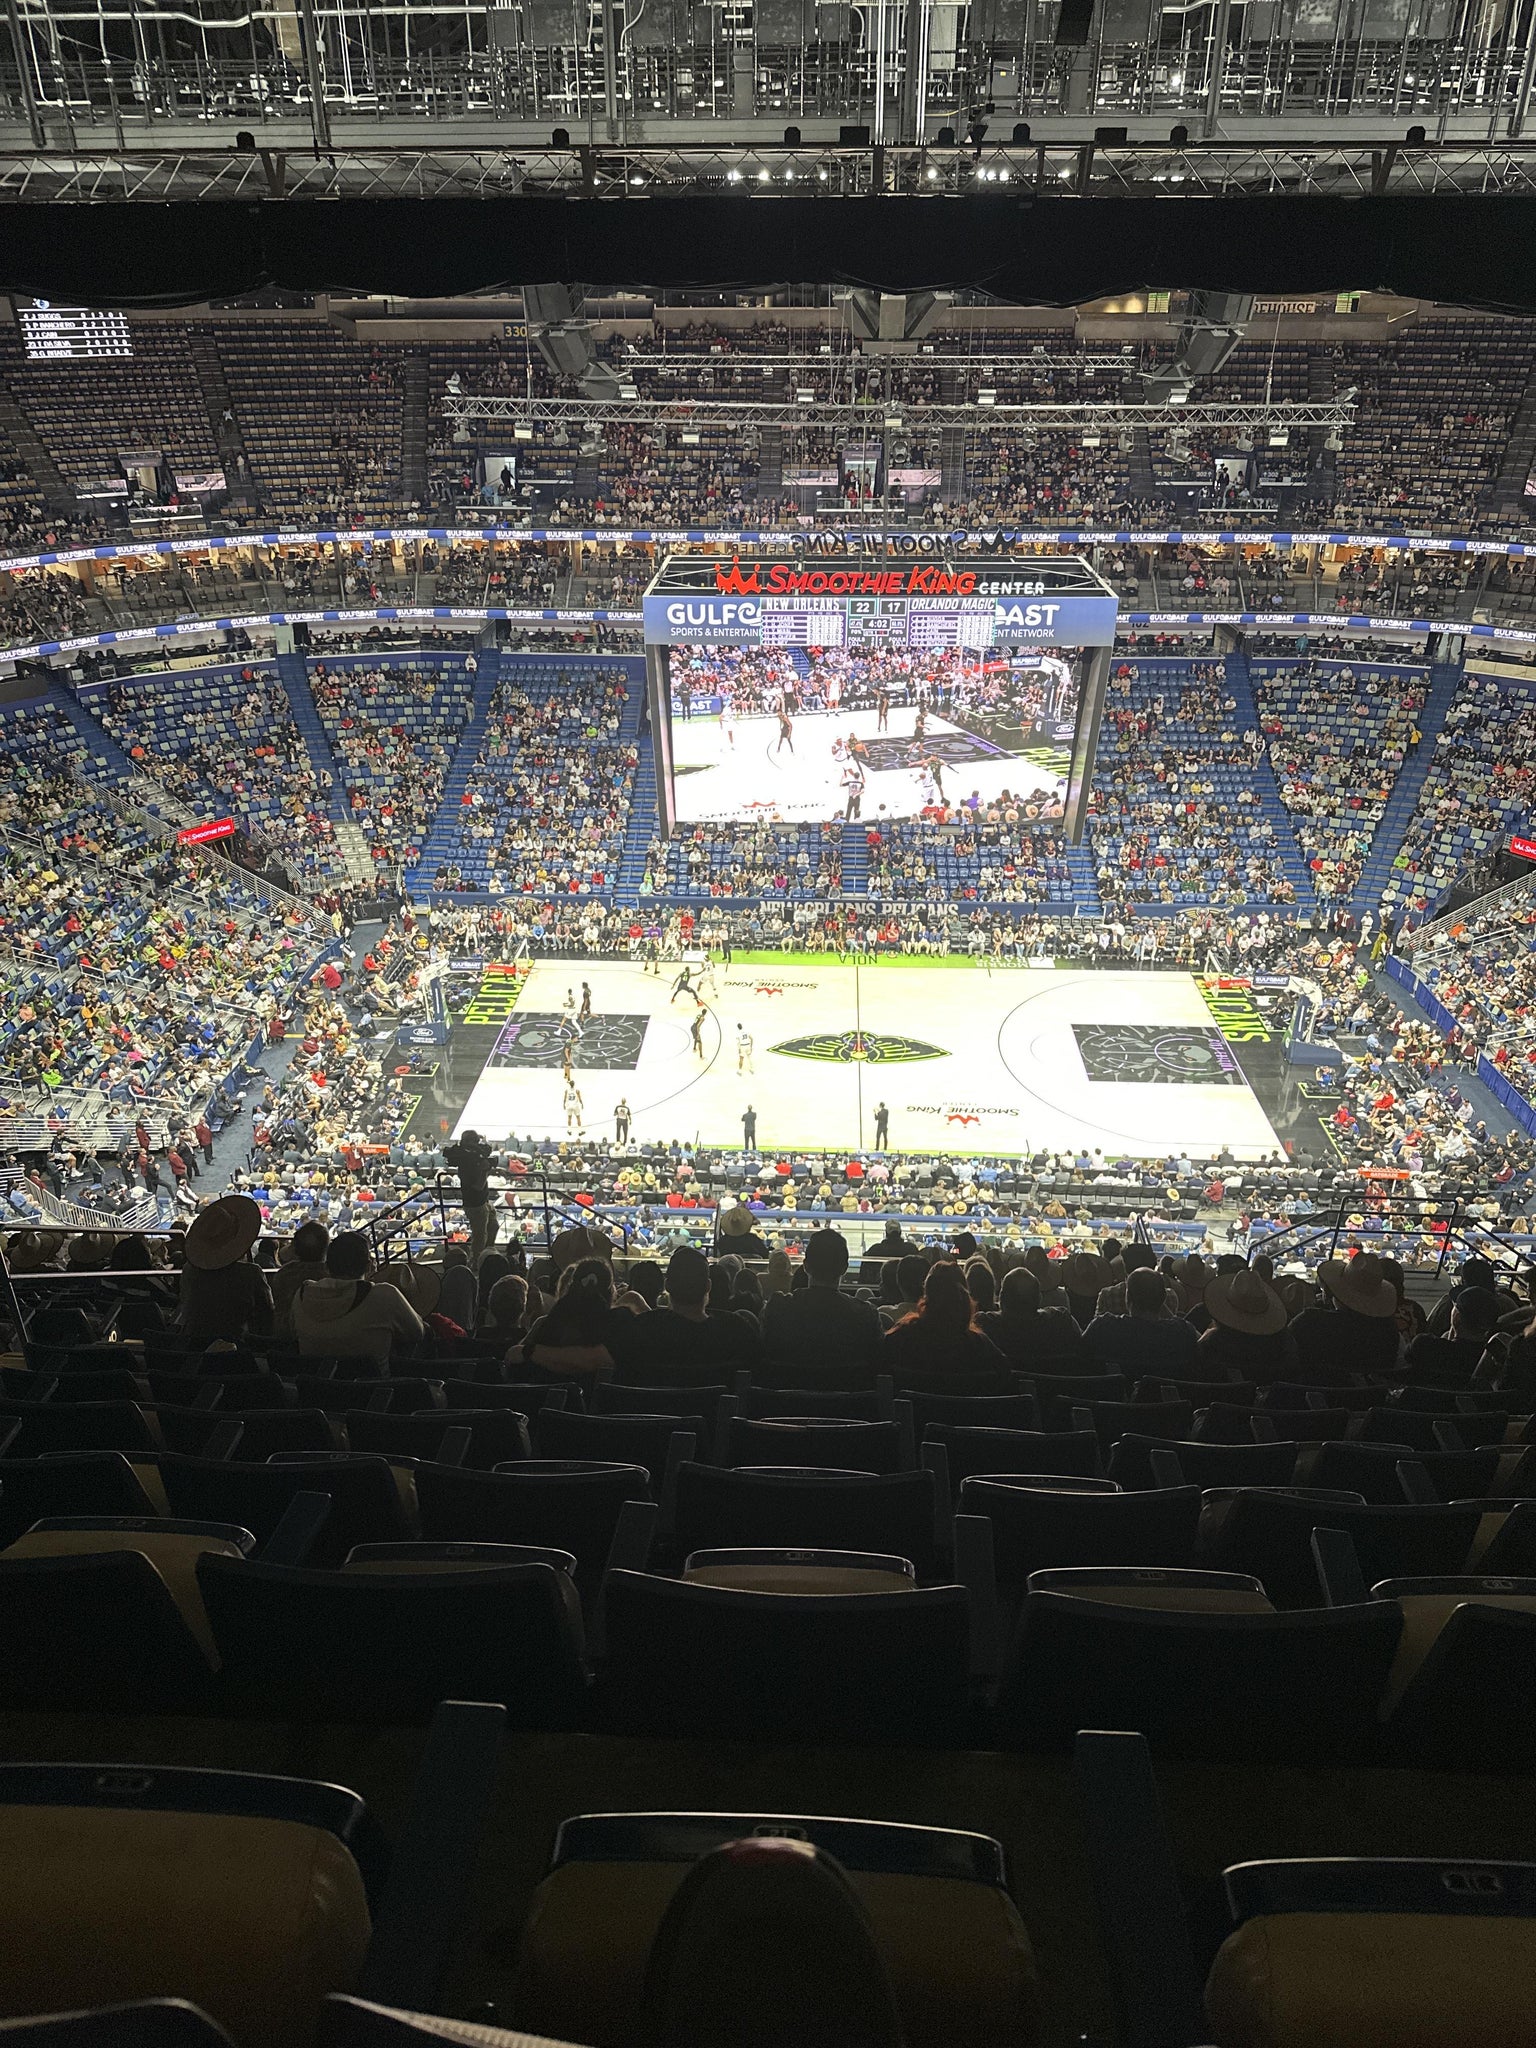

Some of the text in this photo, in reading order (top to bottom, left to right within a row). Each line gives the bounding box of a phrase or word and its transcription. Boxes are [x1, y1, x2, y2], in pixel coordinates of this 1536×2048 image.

[505, 326, 527, 337] 330
[767, 566, 904, 594] SMOOTHIE
[979, 582, 1045, 595] CENTER
[766, 598, 840, 610] NEW ORLEANS
[856, 602, 870, 613] 22
[887, 602, 901, 613] 17
[911, 598, 995, 610] ORLANDO MAGIC
[868, 619, 888, 628] 4:02
[670, 627, 761, 637] SPORTS & ENTERTAIN
[1011, 629, 1055, 637] NETWORK
[947, 1107, 1020, 1116] SMOOTHIE
